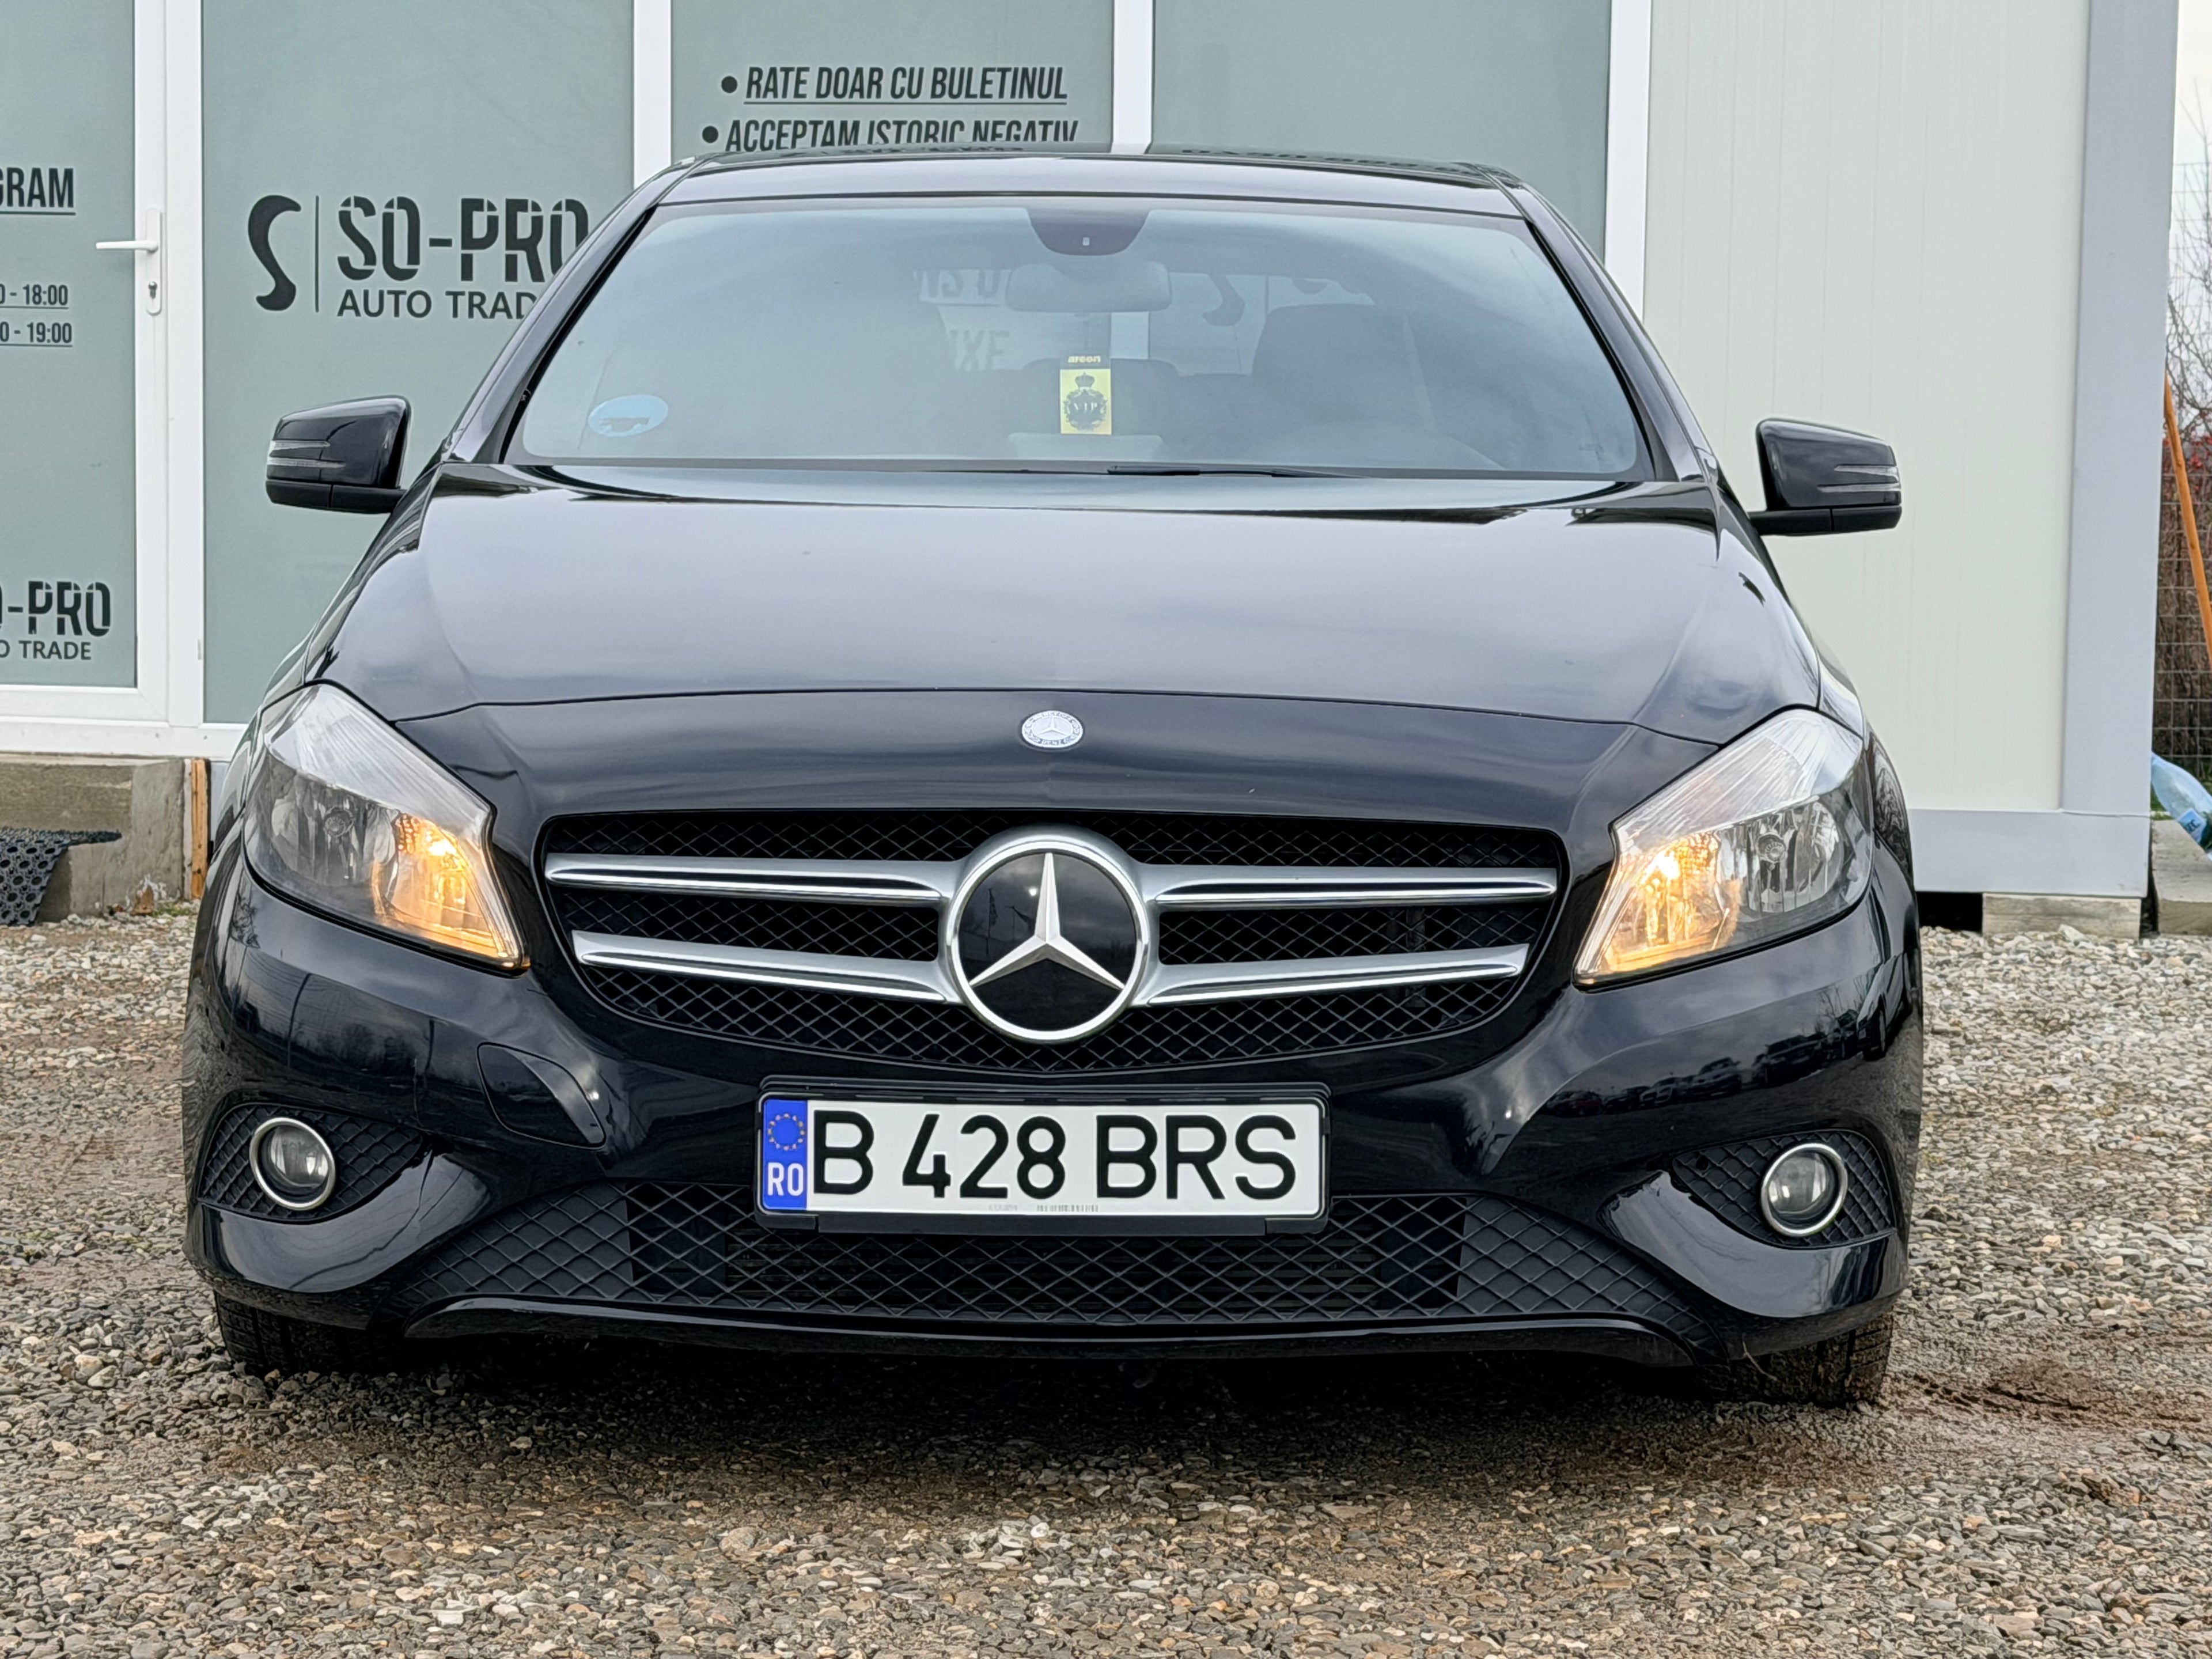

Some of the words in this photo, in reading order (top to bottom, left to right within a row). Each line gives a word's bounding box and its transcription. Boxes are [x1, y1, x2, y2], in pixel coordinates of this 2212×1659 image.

[746, 66, 810, 99] RATE
[815, 66, 883, 99] DOAR
[891, 66, 924, 100] CU
[930, 66, 1067, 99] BULETINUL
[725, 119, 860, 152] ACCEPTAM
[867, 120, 965, 144] ISTORIC
[972, 120, 1078, 142] NEGATIV
[0, 166, 74, 208] RAM
[337, 195, 588, 282] SO-PRO
[22, 283, 68, 306] 18:00
[336, 289, 432, 318] AUTO
[26, 321, 72, 343] 19:00
[0, 581, 111, 637] -PRO
[18, 640, 92, 660] TRADE
[813, 1109, 874, 1195] B
[902, 1113, 1066, 1200] 428
[1096, 1115, 1296, 1200] BRS
[767, 1161, 805, 1196] RO
